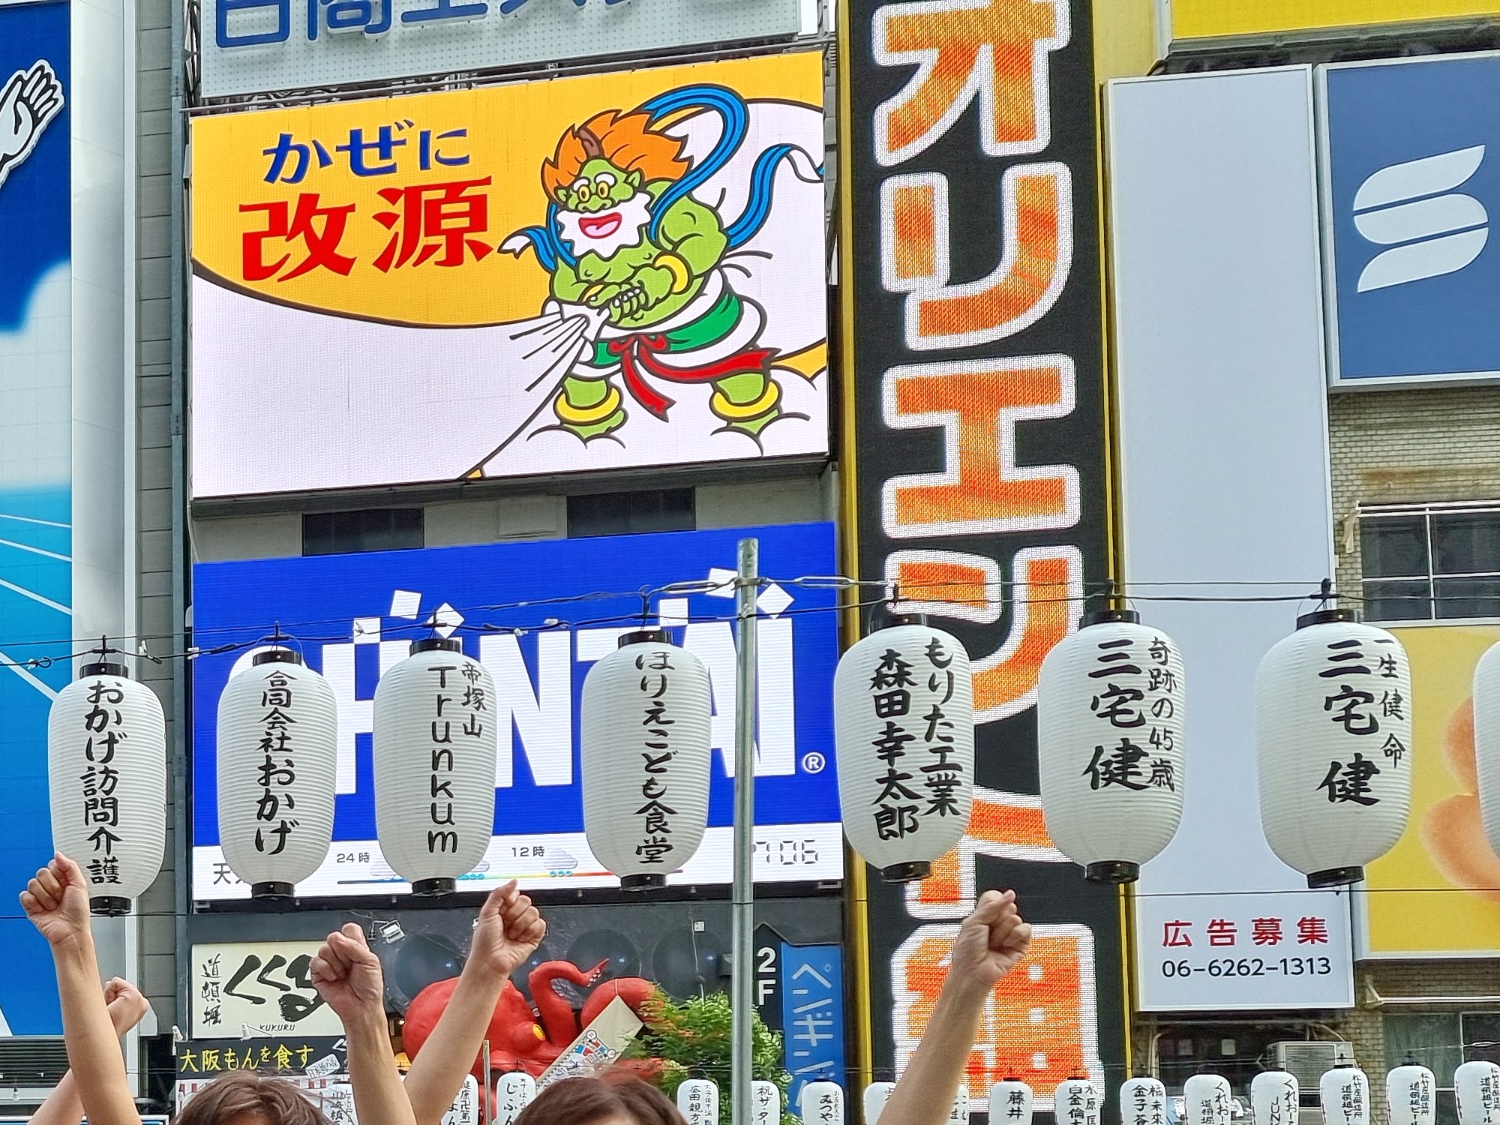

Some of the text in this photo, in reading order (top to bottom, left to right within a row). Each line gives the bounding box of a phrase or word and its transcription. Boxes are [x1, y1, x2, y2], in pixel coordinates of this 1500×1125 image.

[262, 119, 471, 185] かぜに
[238, 176, 497, 284] 改源
[461, 660, 488, 739] 帝塚山
[870, 648, 924, 842] 森田幸太郎
[921, 636, 964, 818] もりた工業
[1083, 638, 1153, 792] 三宅健
[1147, 635, 1179, 792] 奇跡の45歳
[1316, 638, 1382, 807] 三宅健
[1373, 637, 1407, 769] 一生健命
[79, 679, 129, 886] おかげ訪問介護
[254, 669, 299, 856] 合同会社おかげ
[635, 651, 680, 865] ほりえこども食堂
[757, 947, 777, 1006] 2F
[1161, 915, 1330, 948] 広告募集
[1161, 957, 1332, 979] 06-6262-1313
[201, 953, 223, 1028] 道頓堀
[259, 1024, 296, 1032] KUKURU
[180, 1043, 315, 1074] 大阪もんを食す
[1479, 1076, 1492, 1123] 道頓堀ビール
